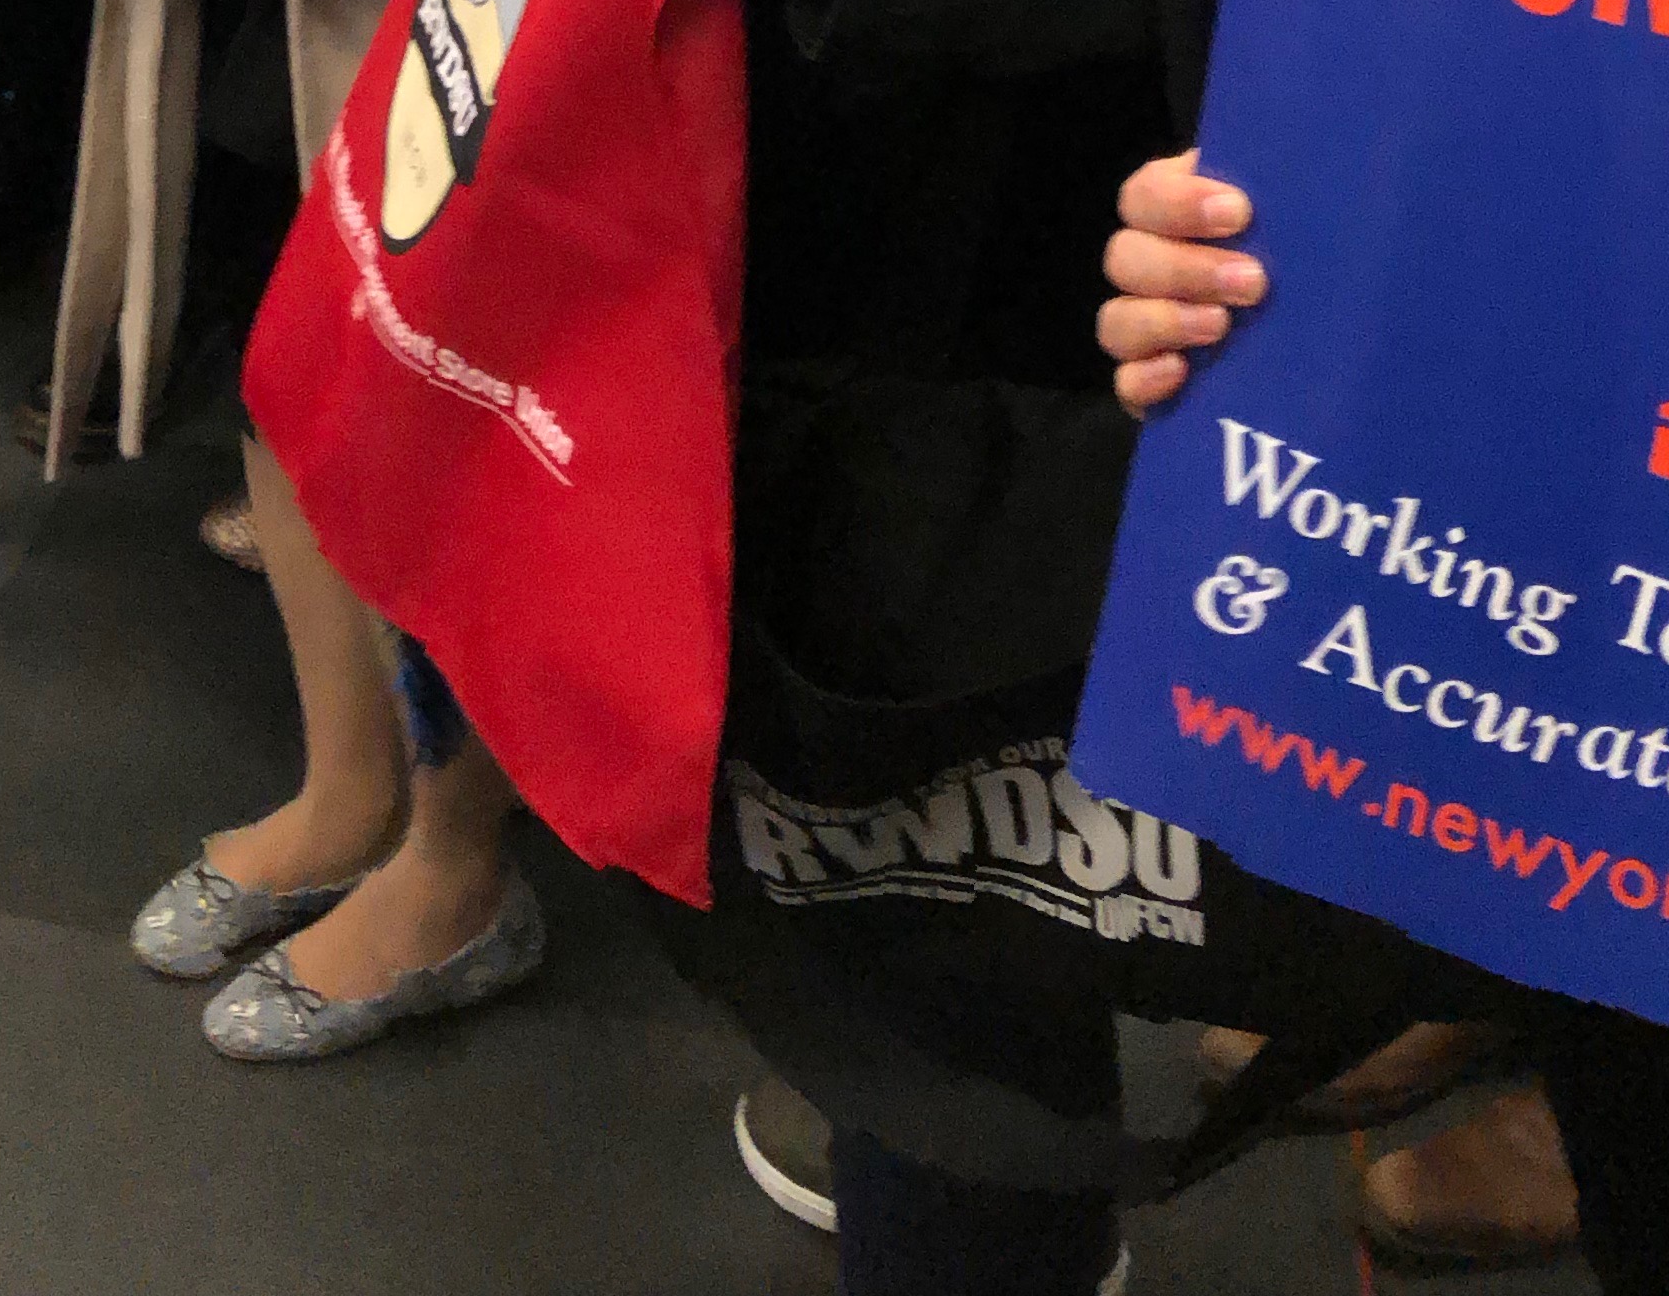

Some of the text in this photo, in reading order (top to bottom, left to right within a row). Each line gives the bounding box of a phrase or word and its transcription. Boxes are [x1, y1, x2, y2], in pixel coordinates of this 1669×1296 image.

[1193, 553, 1291, 635] &
[1218, 418, 1577, 657] Working
[736, 764, 1202, 903] RWDSU
